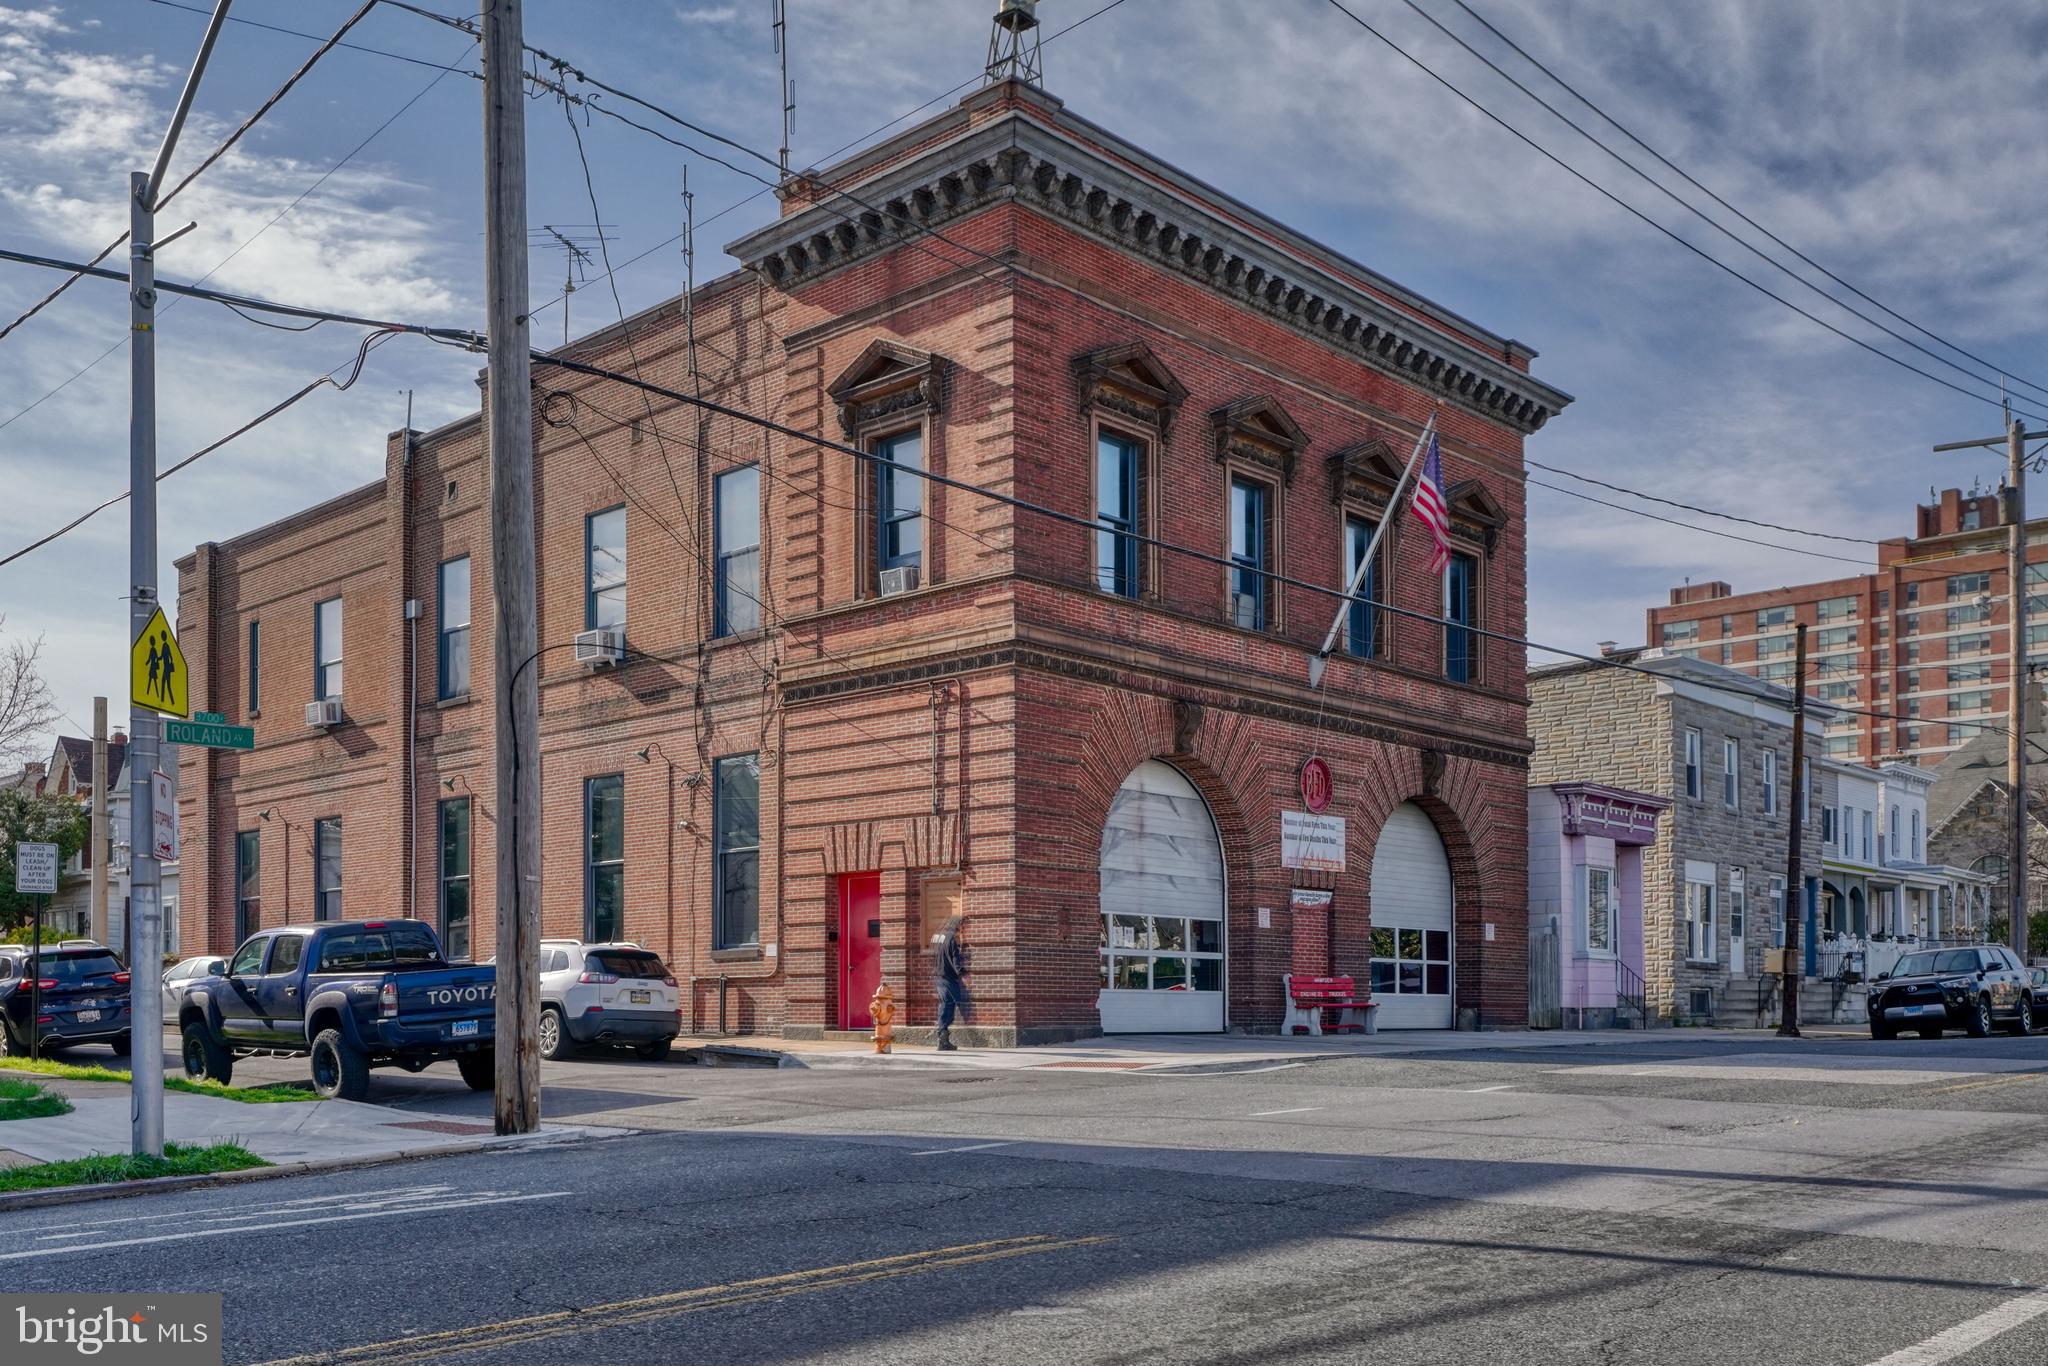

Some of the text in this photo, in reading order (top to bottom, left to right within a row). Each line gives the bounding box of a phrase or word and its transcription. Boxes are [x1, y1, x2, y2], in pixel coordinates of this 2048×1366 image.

[195, 712, 219, 723] 3700
[171, 724, 243, 745] ROLAND AV
